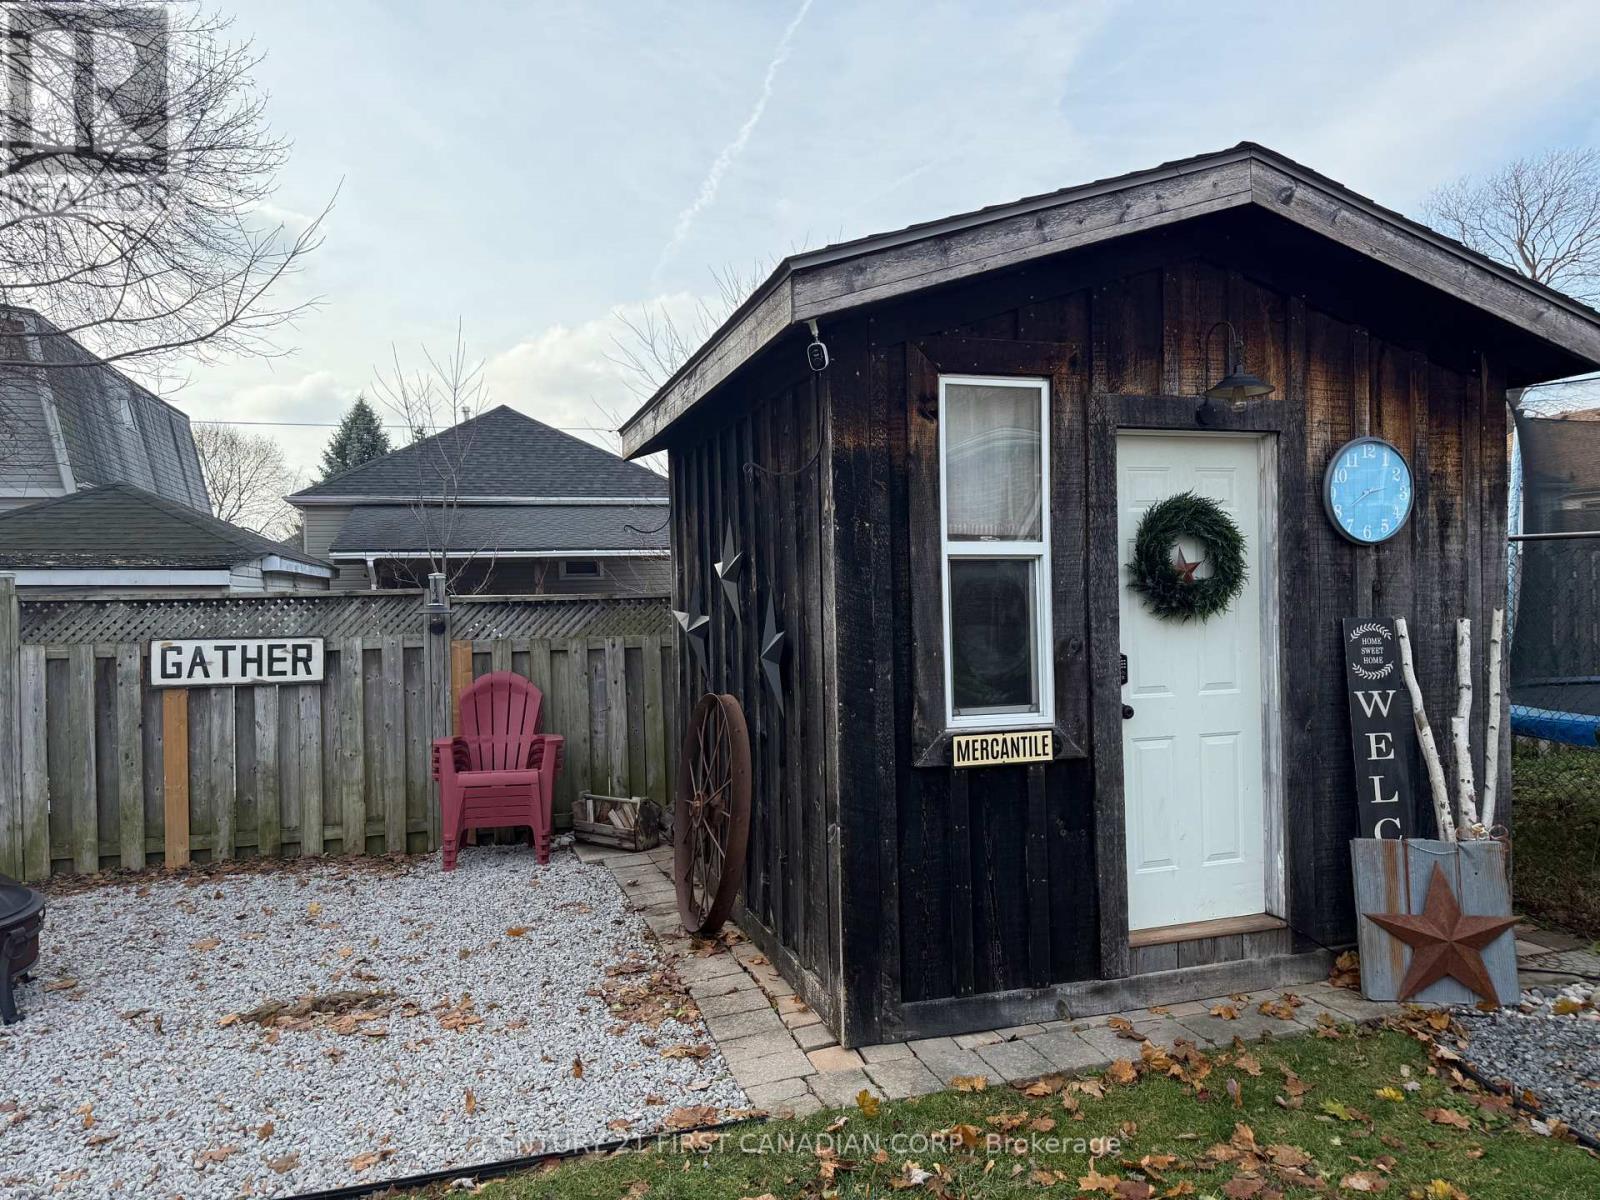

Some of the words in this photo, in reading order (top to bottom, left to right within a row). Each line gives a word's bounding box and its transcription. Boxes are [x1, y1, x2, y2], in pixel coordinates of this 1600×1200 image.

[1361, 444, 1376, 459] 12
[1381, 451, 1390, 467] 1
[1345, 452, 1359, 467] 11
[1333, 468, 1348, 483] 10
[1392, 467, 1401, 482] 2
[1400, 485, 1408, 501] 3
[1363, 524, 1372, 539] 6
[1380, 518, 1390, 533] 5
[1361, 637, 1382, 645] HOME
[1361, 646, 1384, 655] SWEET
[160, 643, 313, 679] GATHER
[1363, 656, 1384, 664] HOME
[956, 734, 1050, 762] MERCANTILE
